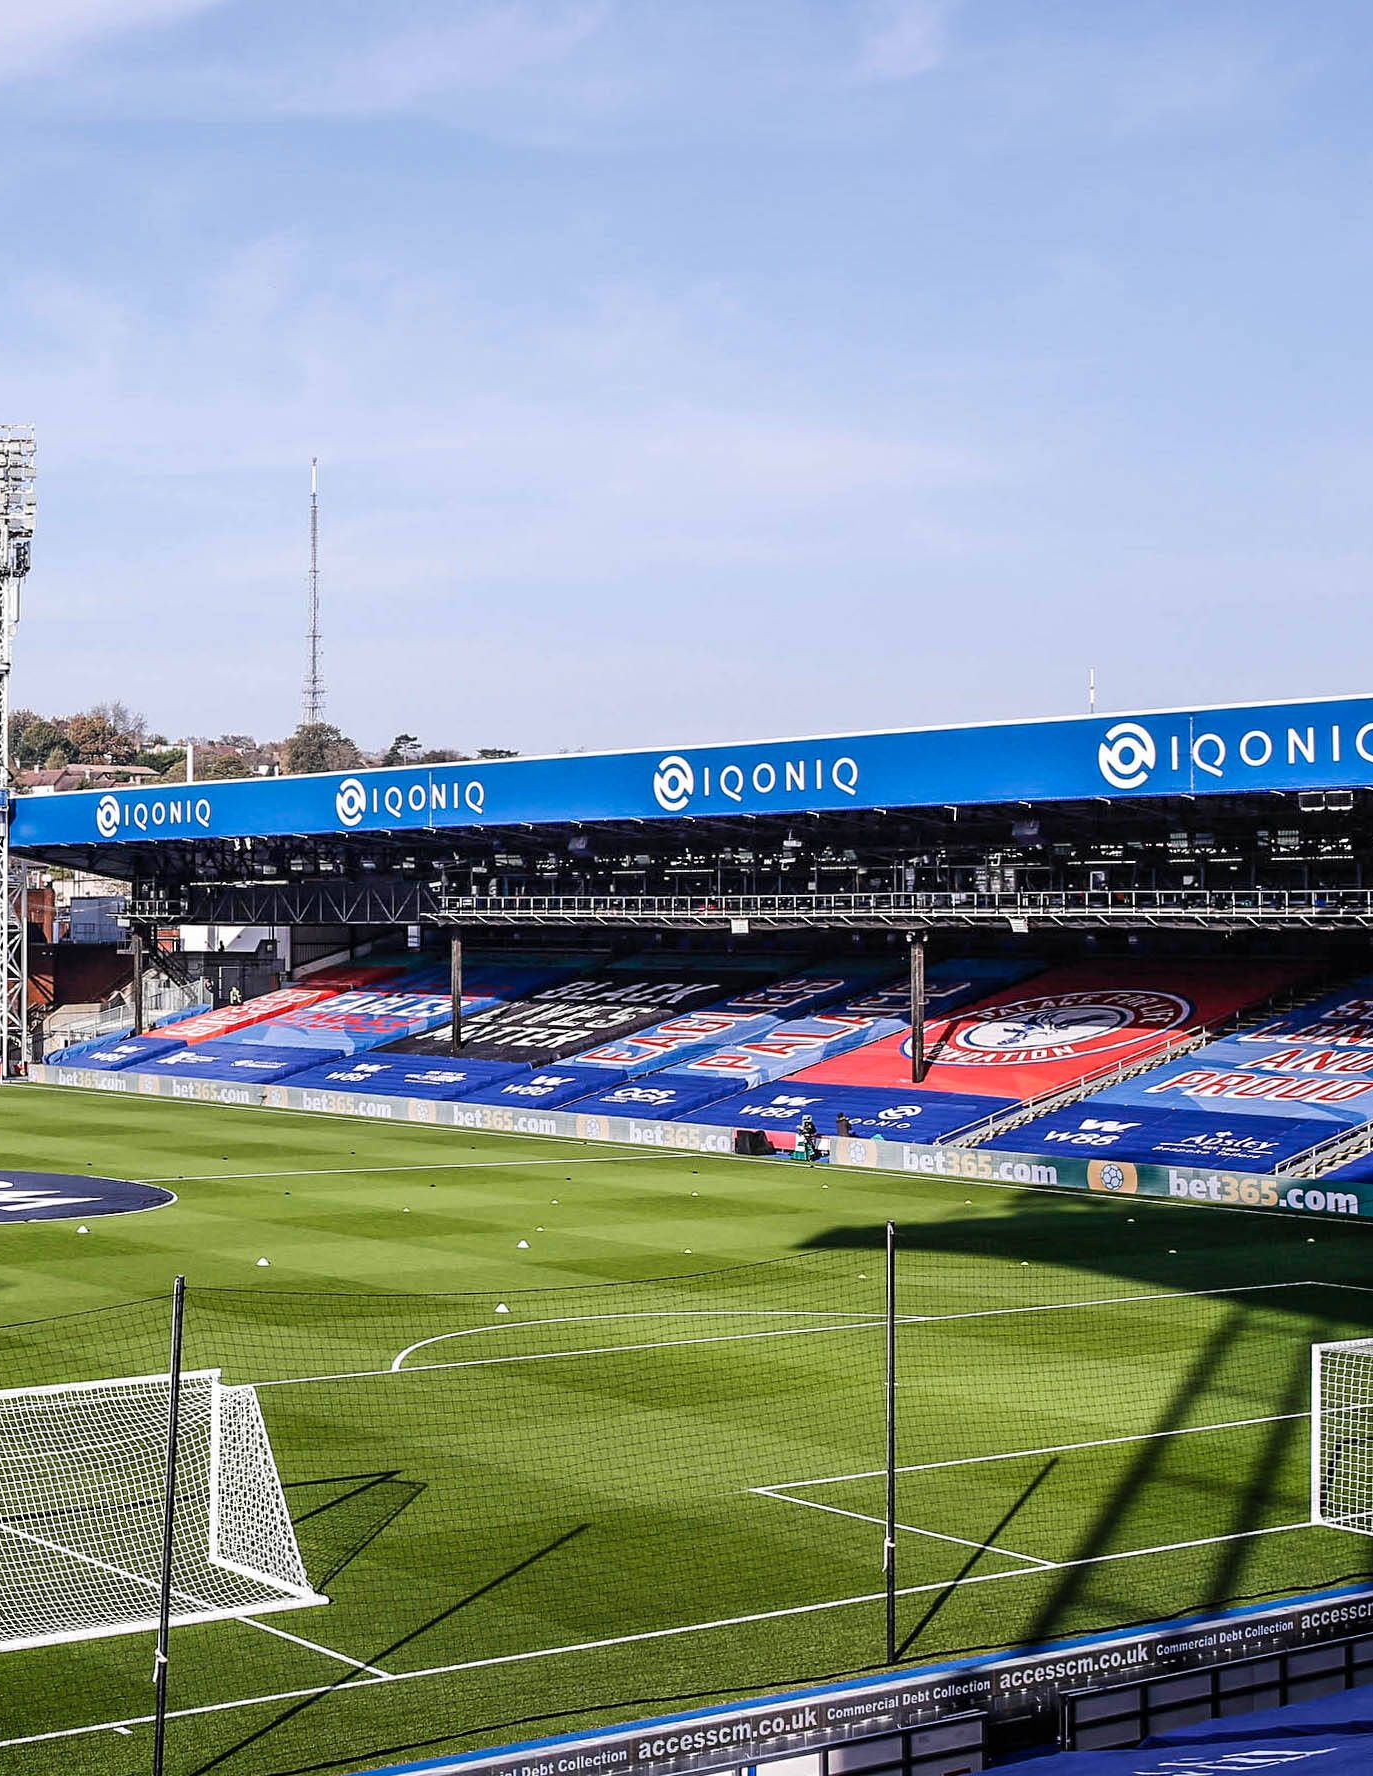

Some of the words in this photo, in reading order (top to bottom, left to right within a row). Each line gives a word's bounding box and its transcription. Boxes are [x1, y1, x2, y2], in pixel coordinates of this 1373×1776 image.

[704, 756, 859, 803] IQONIQ
[372, 780, 486, 817] IQONIQ
[124, 798, 212, 832] IQONIQ
[533, 981, 721, 1004] BLACK
[979, 993, 1100, 1019] PALACE
[468, 1000, 660, 1030] LIVES
[576, 978, 845, 1066] EAGLES
[416, 1024, 595, 1049] MATTER
[1236, 1021, 1373, 1048] LON
[1234, 1048, 1373, 1074] AND
[58, 1072, 127, 1092] bet365.com
[172, 1079, 250, 1105] bet365.com
[1144, 1071, 1373, 1104] PROUD
[303, 1091, 392, 1119] bet365.com
[739, 1104, 801, 1119] W88
[453, 1104, 557, 1136] bet365.com
[1043, 1130, 1121, 1146] W88
[904, 1146, 1058, 1186] bet365.com
[1168, 1169, 1359, 1215] bet365.com
[999, 1643, 1149, 1690] accesscm.co.uk
[1156, 1631, 1218, 1657] Commercial
[1219, 1627, 1243, 1645] Debt
[1244, 1619, 1295, 1641] Collection
[638, 1706, 818, 1760] accesscm.co.uk
[827, 1693, 899, 1721] Commercial
[903, 1687, 930, 1709] Debt
[933, 1678, 992, 1701] Collection
[557, 1750, 628, 1774] Collection
